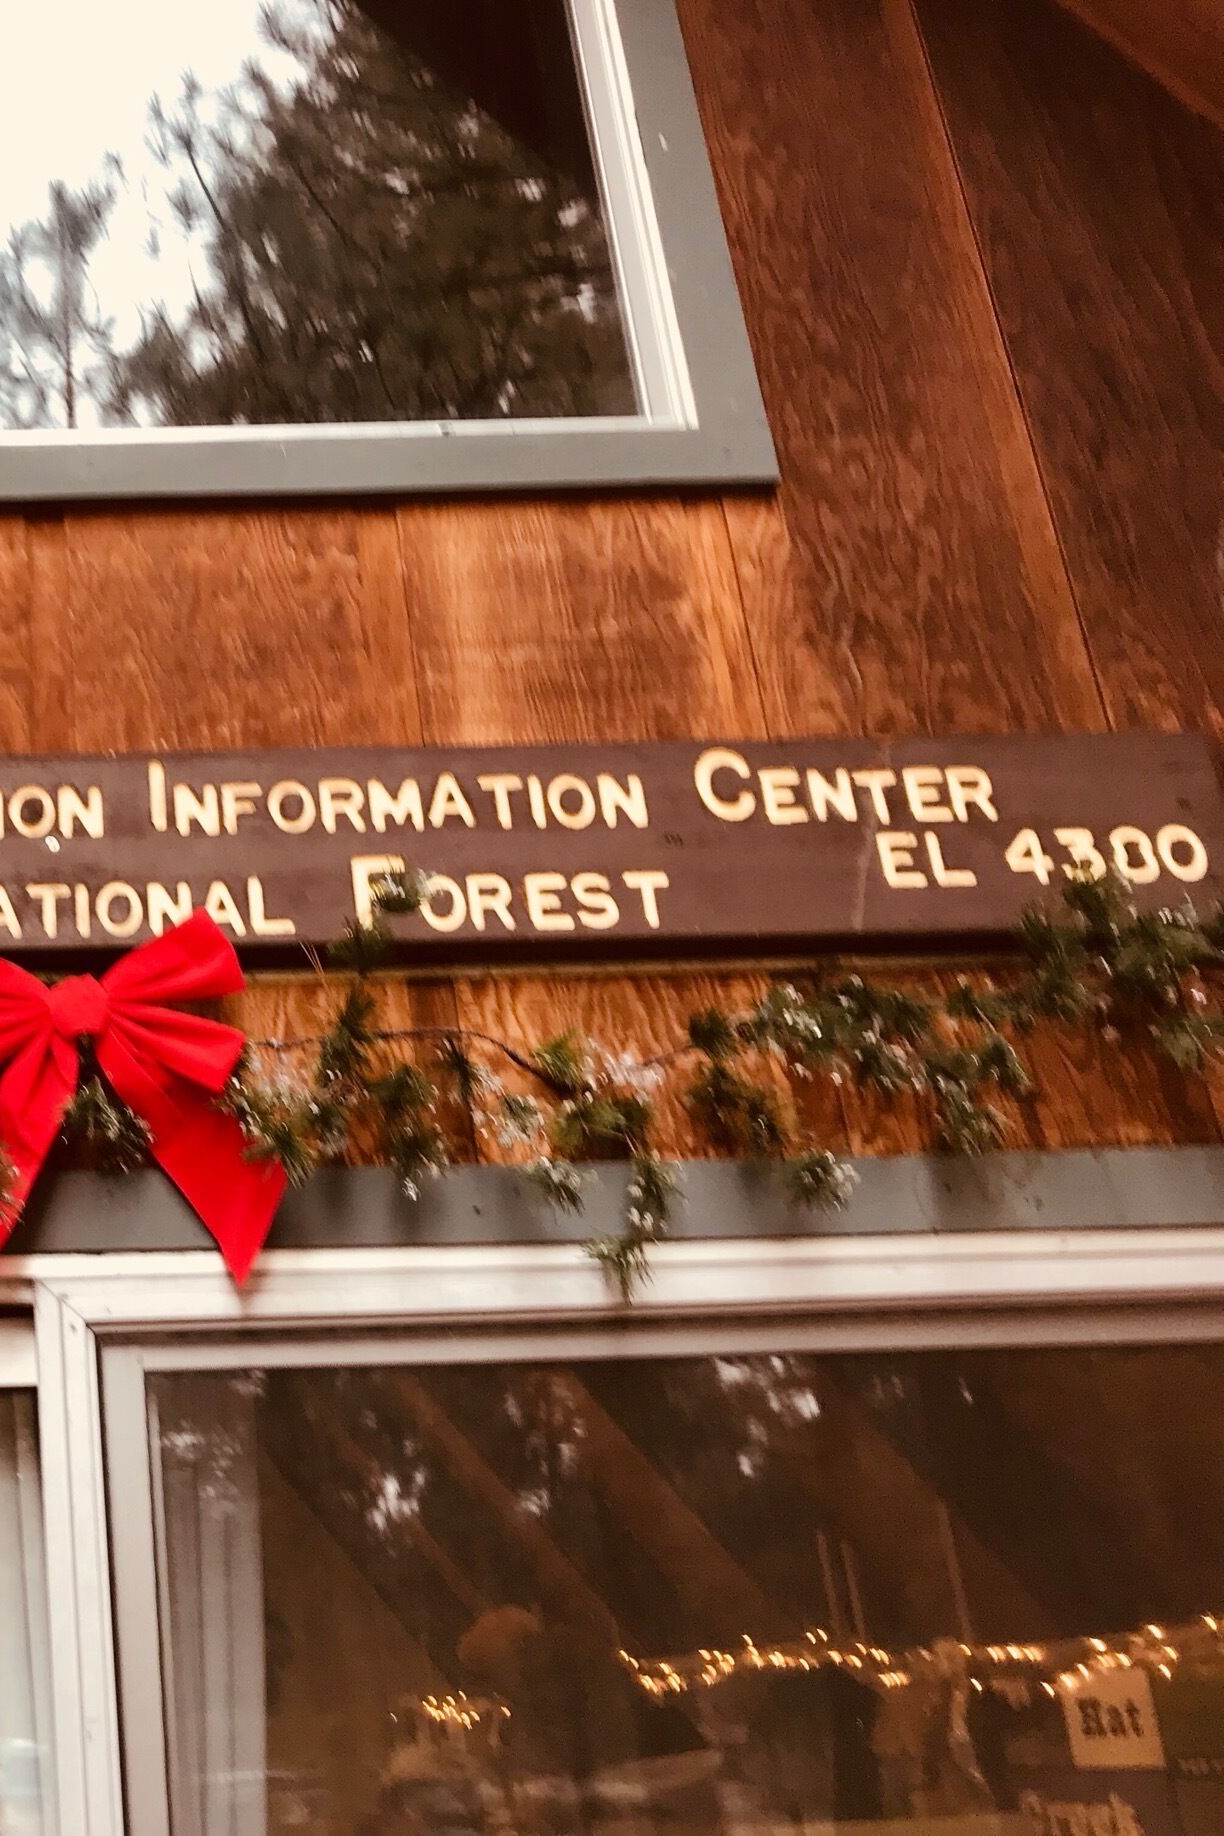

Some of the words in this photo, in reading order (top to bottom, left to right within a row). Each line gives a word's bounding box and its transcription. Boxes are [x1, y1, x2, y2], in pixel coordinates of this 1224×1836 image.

[147, 760, 649, 837] INFORMATION
[694, 748, 999, 826] CENTER
[351, 853, 670, 934] FOREST
[876, 832, 978, 889] EL
